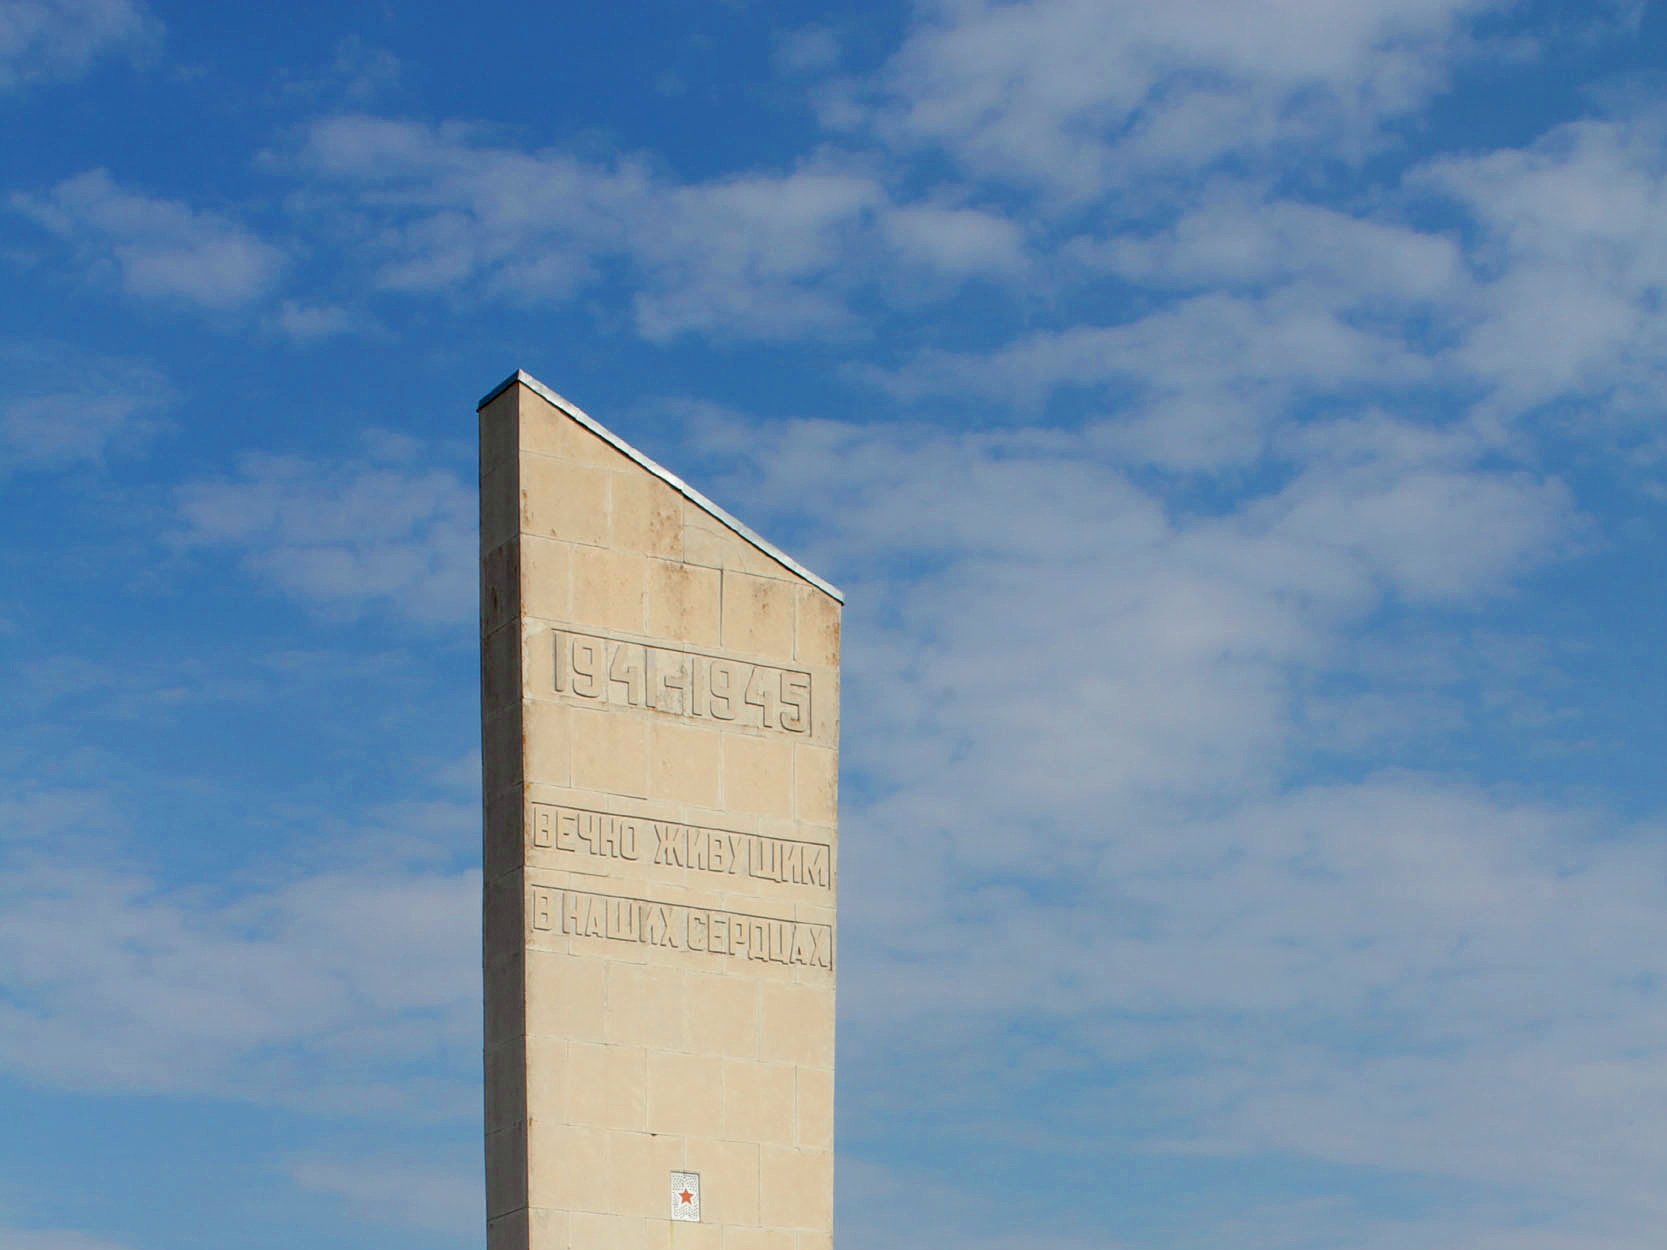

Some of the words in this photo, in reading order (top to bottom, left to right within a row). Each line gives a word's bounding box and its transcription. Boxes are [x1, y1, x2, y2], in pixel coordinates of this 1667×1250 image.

[553, 631, 809, 733] 1941-1945
[533, 805, 639, 861] ВЕЧНО
[653, 822, 828, 888] ЖИВУЩИМ
[533, 888, 552, 931] В
[562, 892, 679, 949] НАШИХ
[687, 915, 831, 969] СЕРДЦАХ
